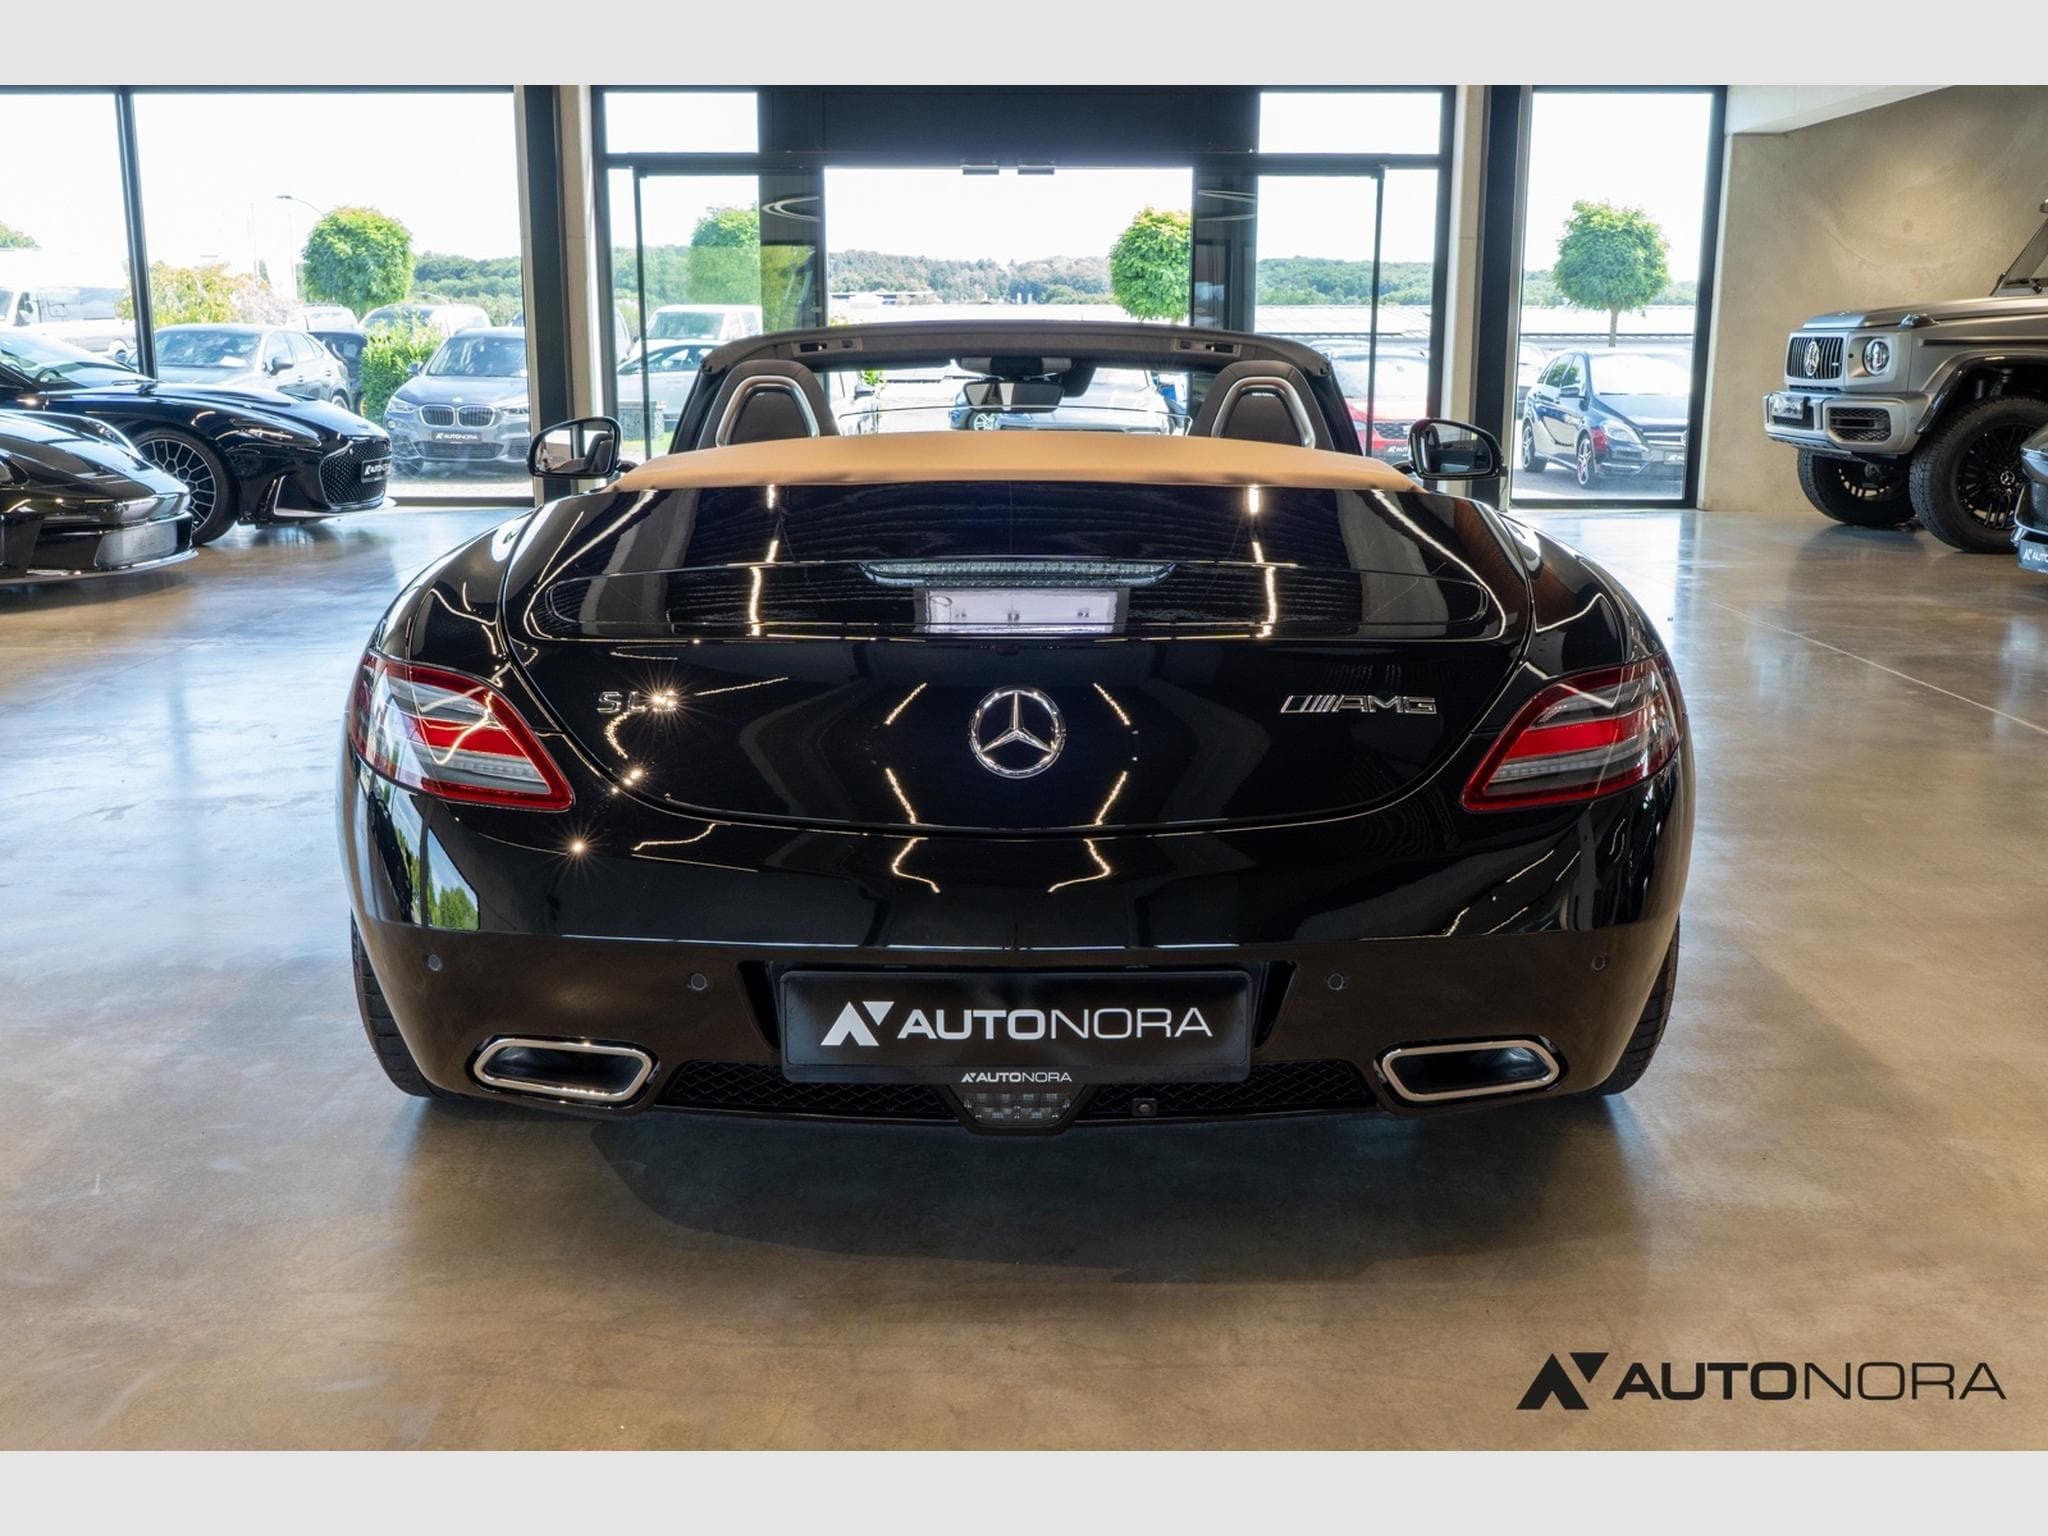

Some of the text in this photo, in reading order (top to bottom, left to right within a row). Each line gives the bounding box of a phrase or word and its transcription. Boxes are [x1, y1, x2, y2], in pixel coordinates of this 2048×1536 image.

[1330, 694, 1437, 714] AMG
[897, 1007, 1213, 1040] AUTONORA
[976, 1071, 1073, 1083] AUTONORA
